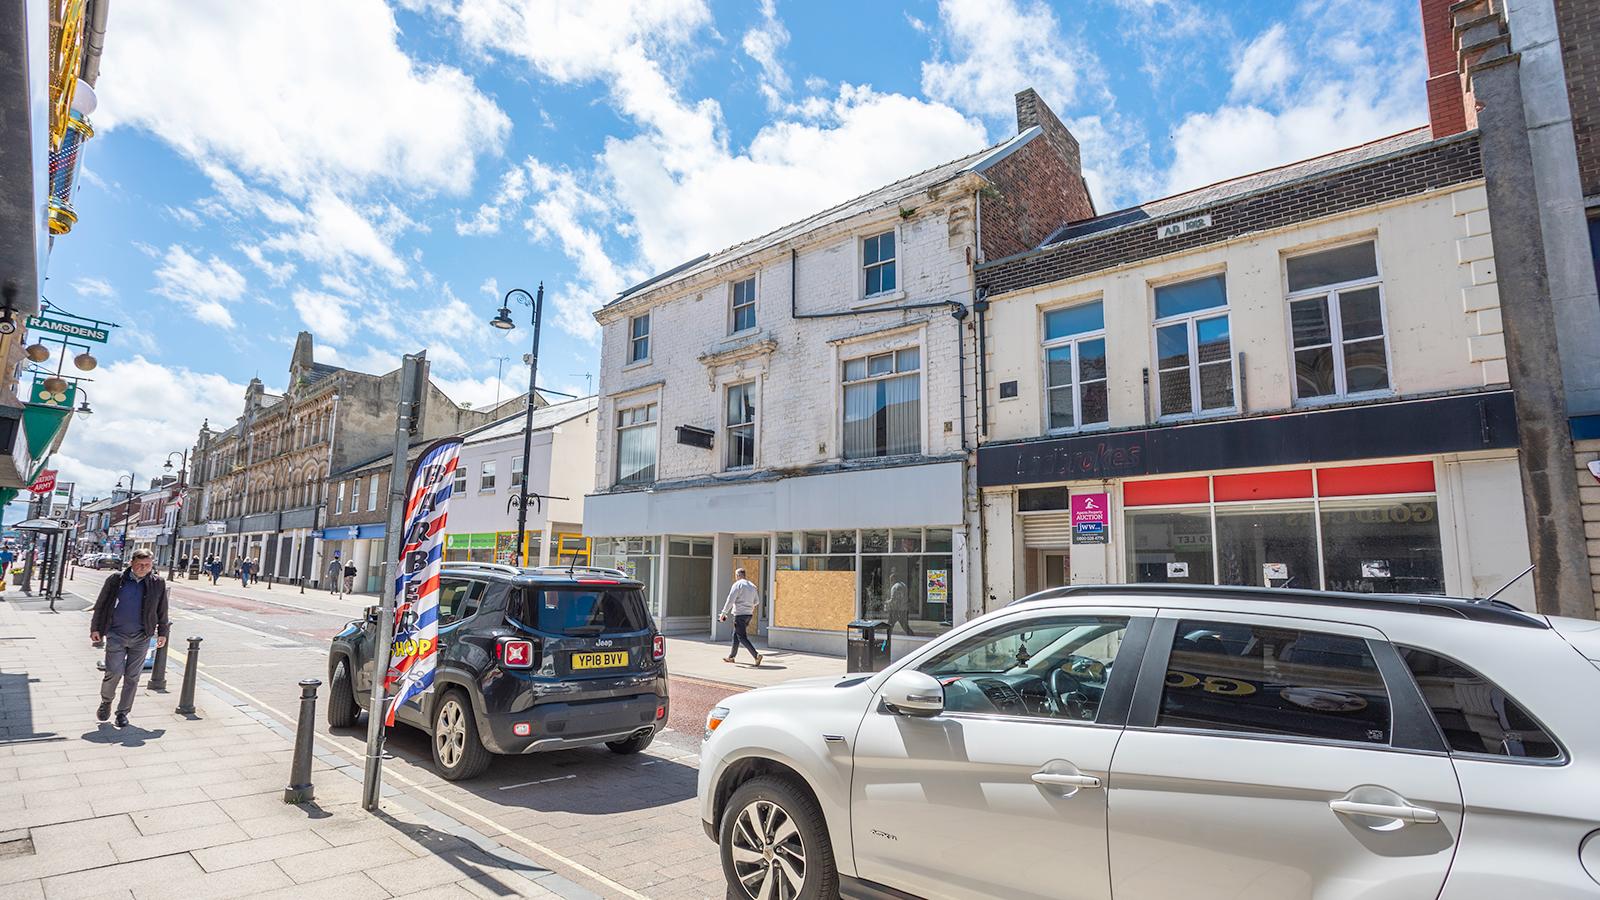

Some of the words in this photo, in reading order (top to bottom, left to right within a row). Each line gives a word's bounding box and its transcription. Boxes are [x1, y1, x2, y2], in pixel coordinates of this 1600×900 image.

[30, 317, 105, 340] RAMSDENS
[33, 480, 53, 491] ARMY
[398, 464, 446, 634] BARBER
[391, 638, 432, 657] HOP
[595, 639, 613, 647] Jeep
[579, 654, 602, 666] YP18
[604, 653, 623, 665] BVV
